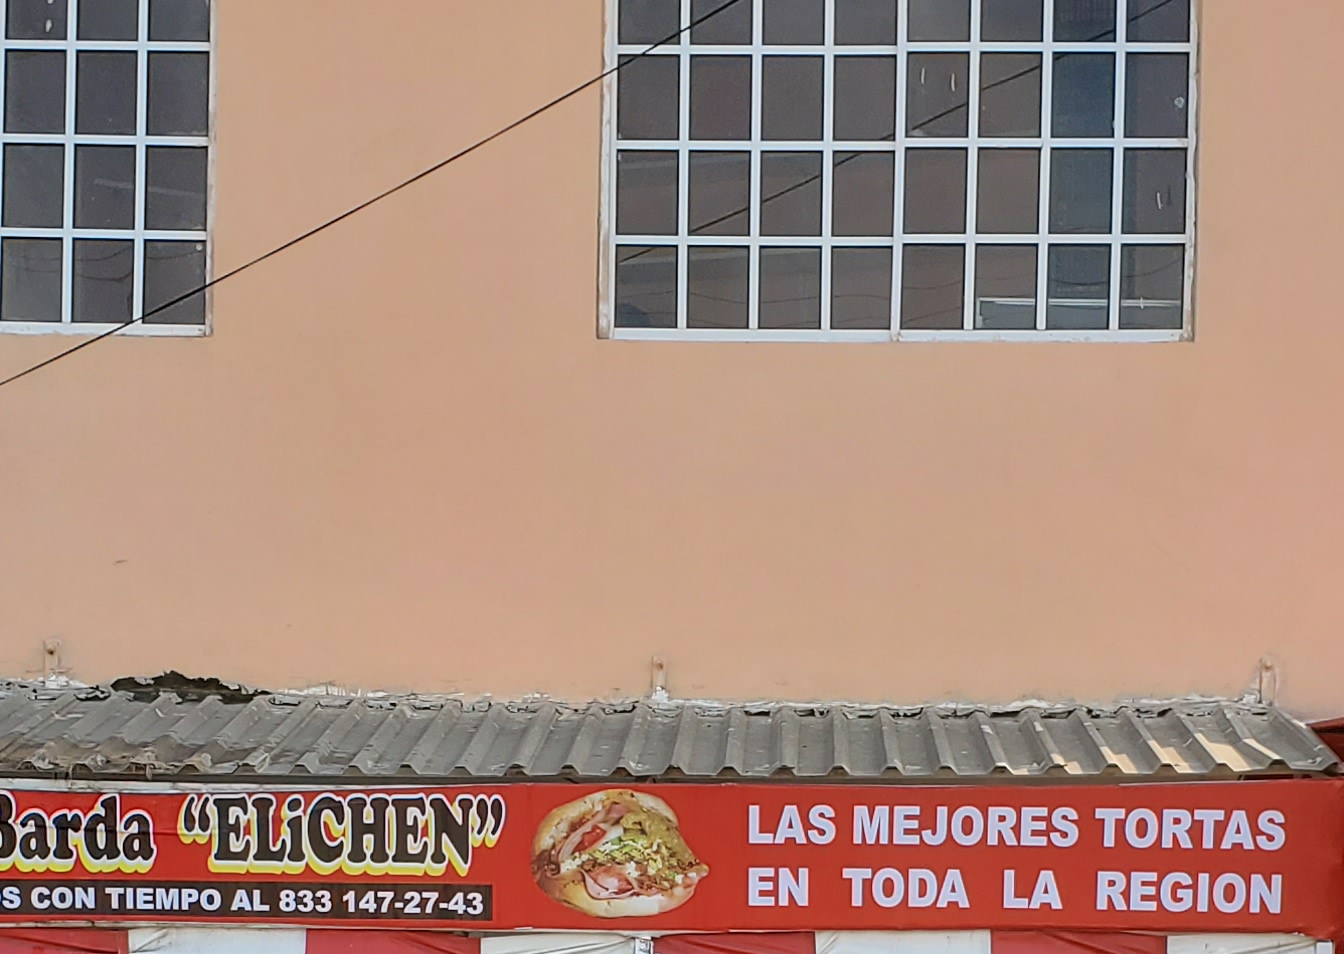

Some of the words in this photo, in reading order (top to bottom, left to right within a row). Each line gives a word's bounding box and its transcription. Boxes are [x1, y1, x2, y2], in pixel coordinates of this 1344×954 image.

[748, 804, 836, 845] LAS
[852, 805, 1079, 847] MEJORES
[1094, 807, 1286, 850] TORTAS
[30, 886, 95, 910] CON
[105, 887, 222, 911] TIEMPO
[230, 890, 270, 912] AL
[278, 889, 332, 913] 833
[343, 891, 484, 915] 147-27-43
[747, 867, 809, 906] EN
[841, 867, 970, 908] TODA
[1003, 869, 1063, 910] LA
[1096, 870, 1283, 914] REGION
